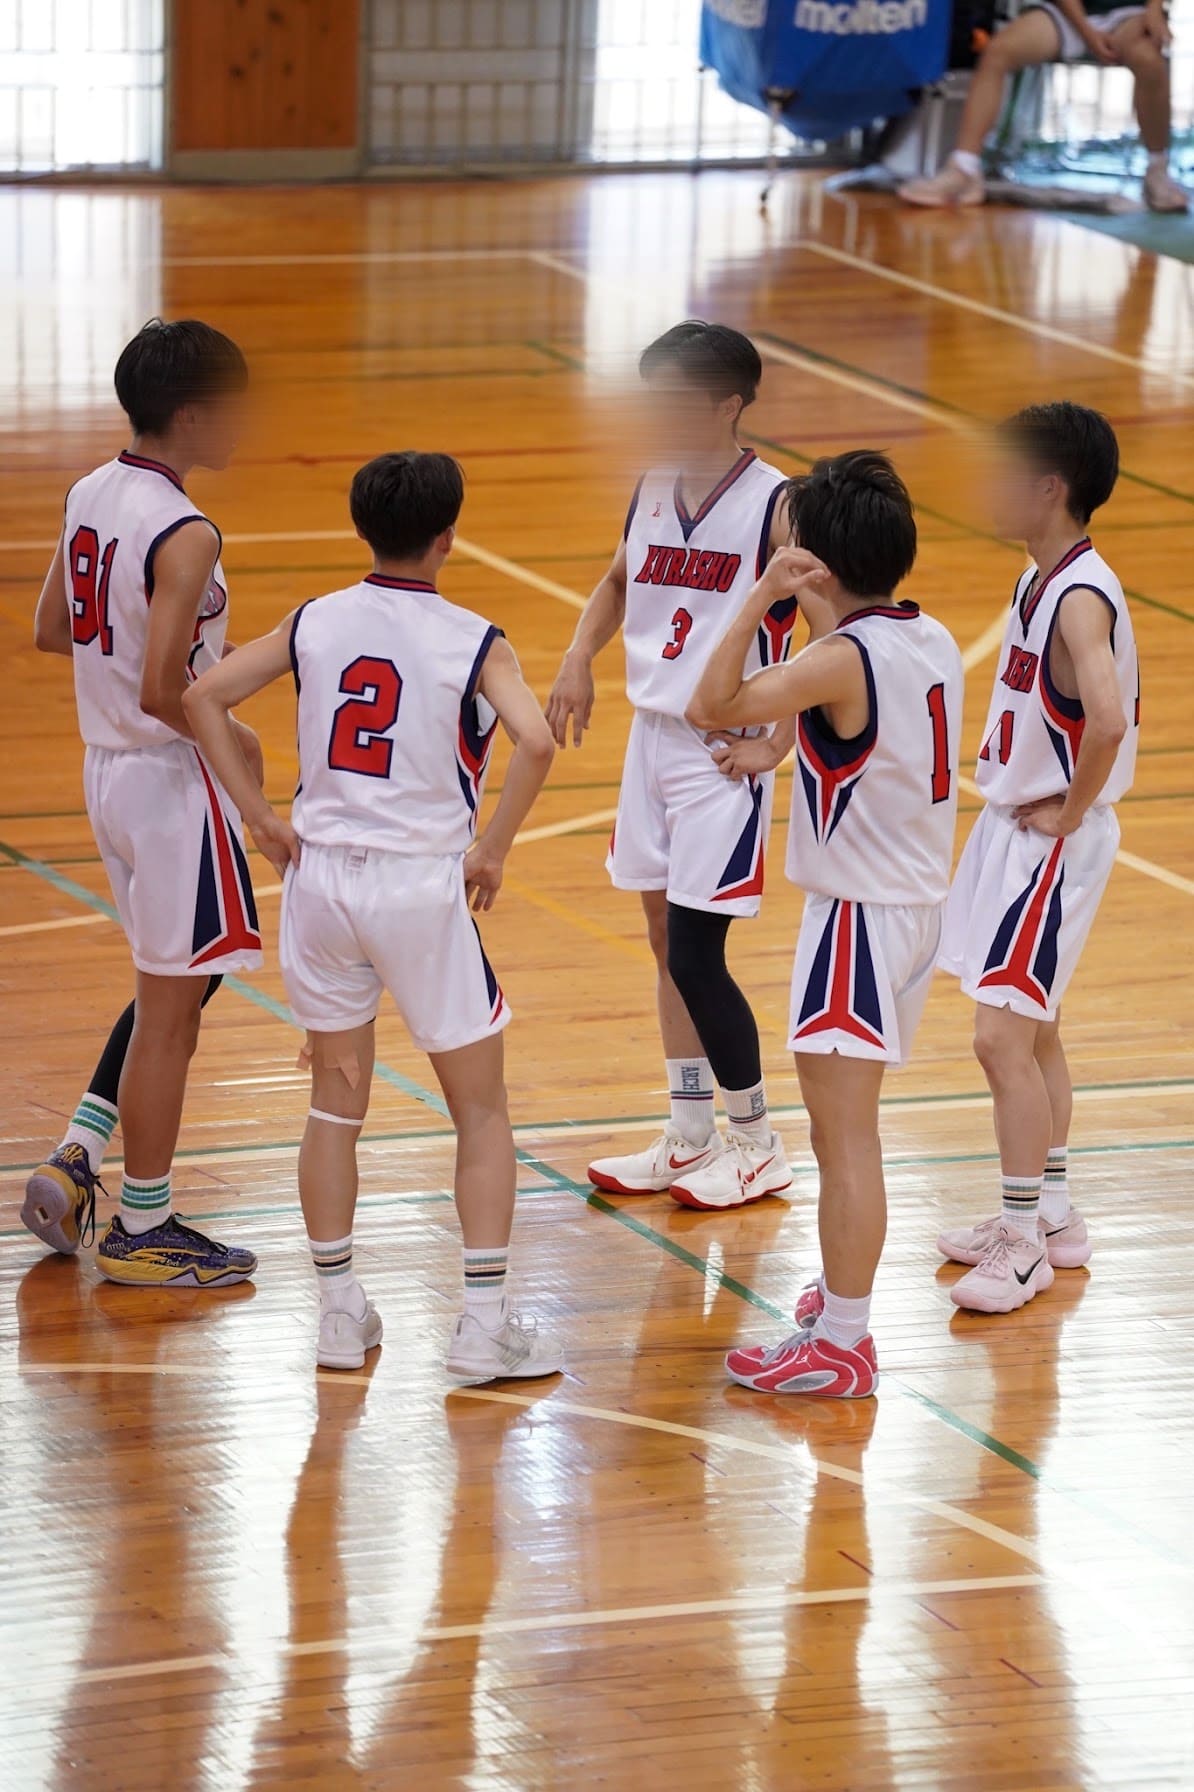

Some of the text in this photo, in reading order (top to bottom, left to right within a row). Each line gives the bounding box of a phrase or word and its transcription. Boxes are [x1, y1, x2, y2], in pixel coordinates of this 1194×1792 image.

[795, 0, 928, 35] molten
[69, 525, 119, 656] 91
[634, 544, 742, 593] KURASHO
[661, 607, 693, 660] 3
[328, 655, 403, 779] 2
[926, 682, 951, 805] 1
[681, 1066, 700, 1091] ARCH
